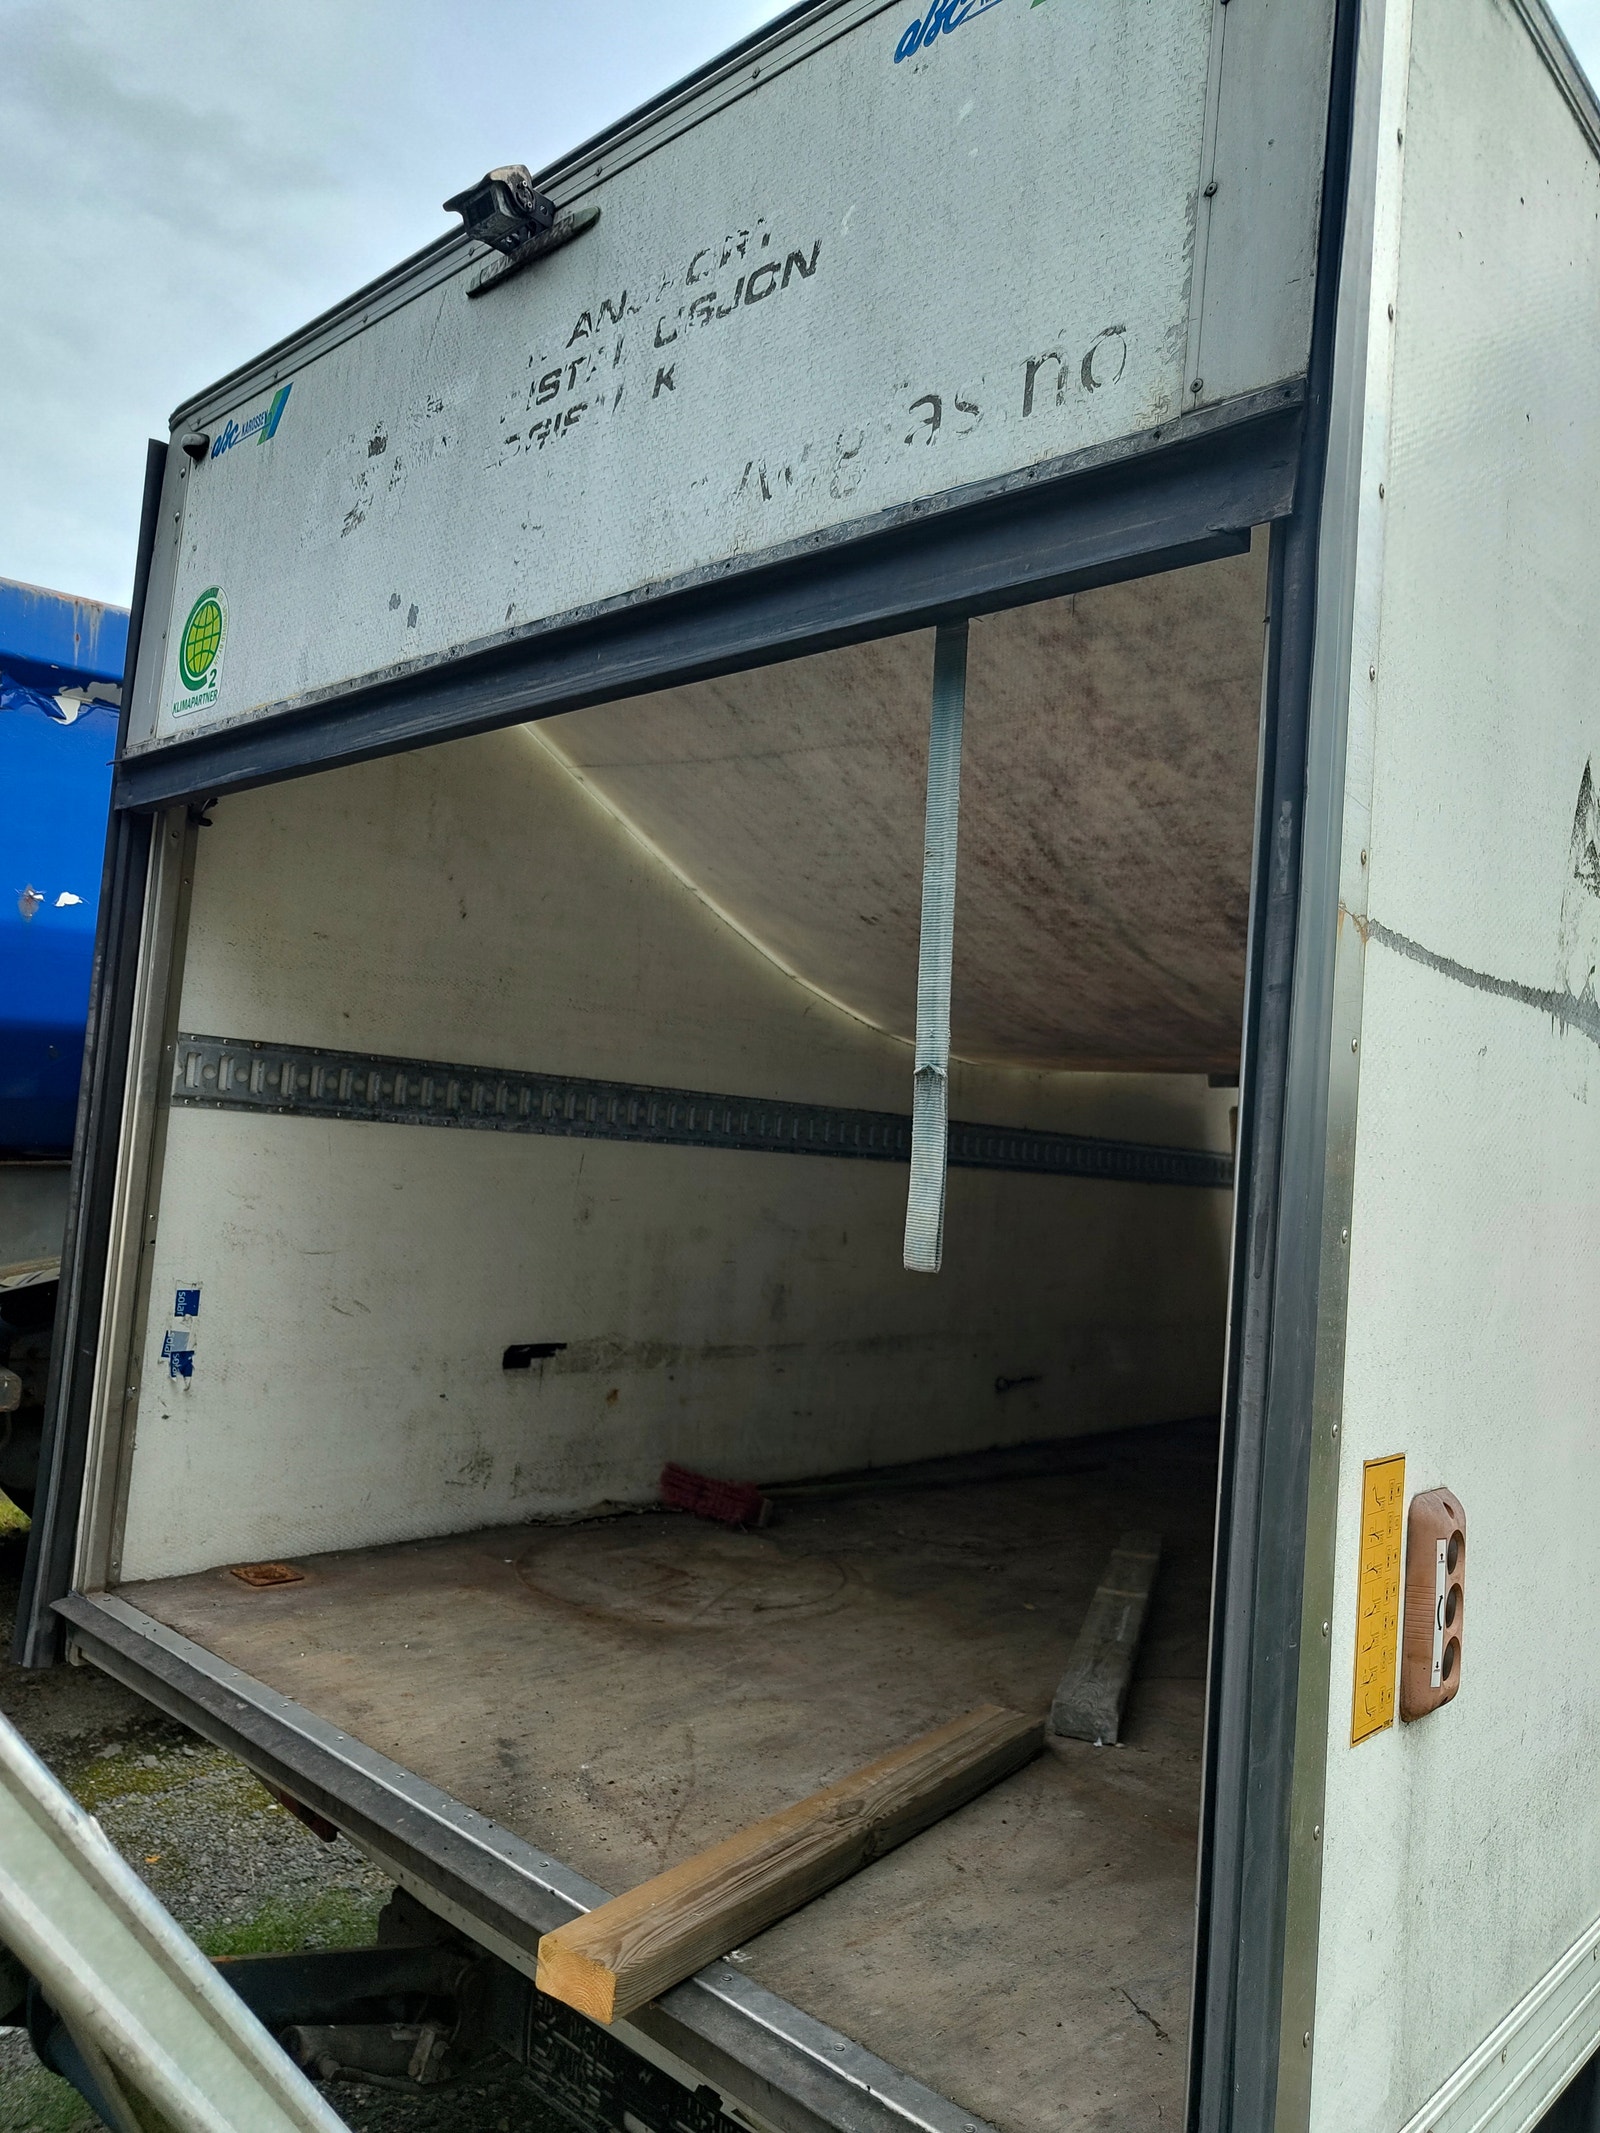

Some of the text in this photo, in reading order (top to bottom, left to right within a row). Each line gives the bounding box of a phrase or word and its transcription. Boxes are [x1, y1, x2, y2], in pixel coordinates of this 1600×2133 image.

[211, 419, 241, 460] abc
[172, 689, 219, 714] KLIMAPARTNER
[176, 1291, 188, 1316] solar
